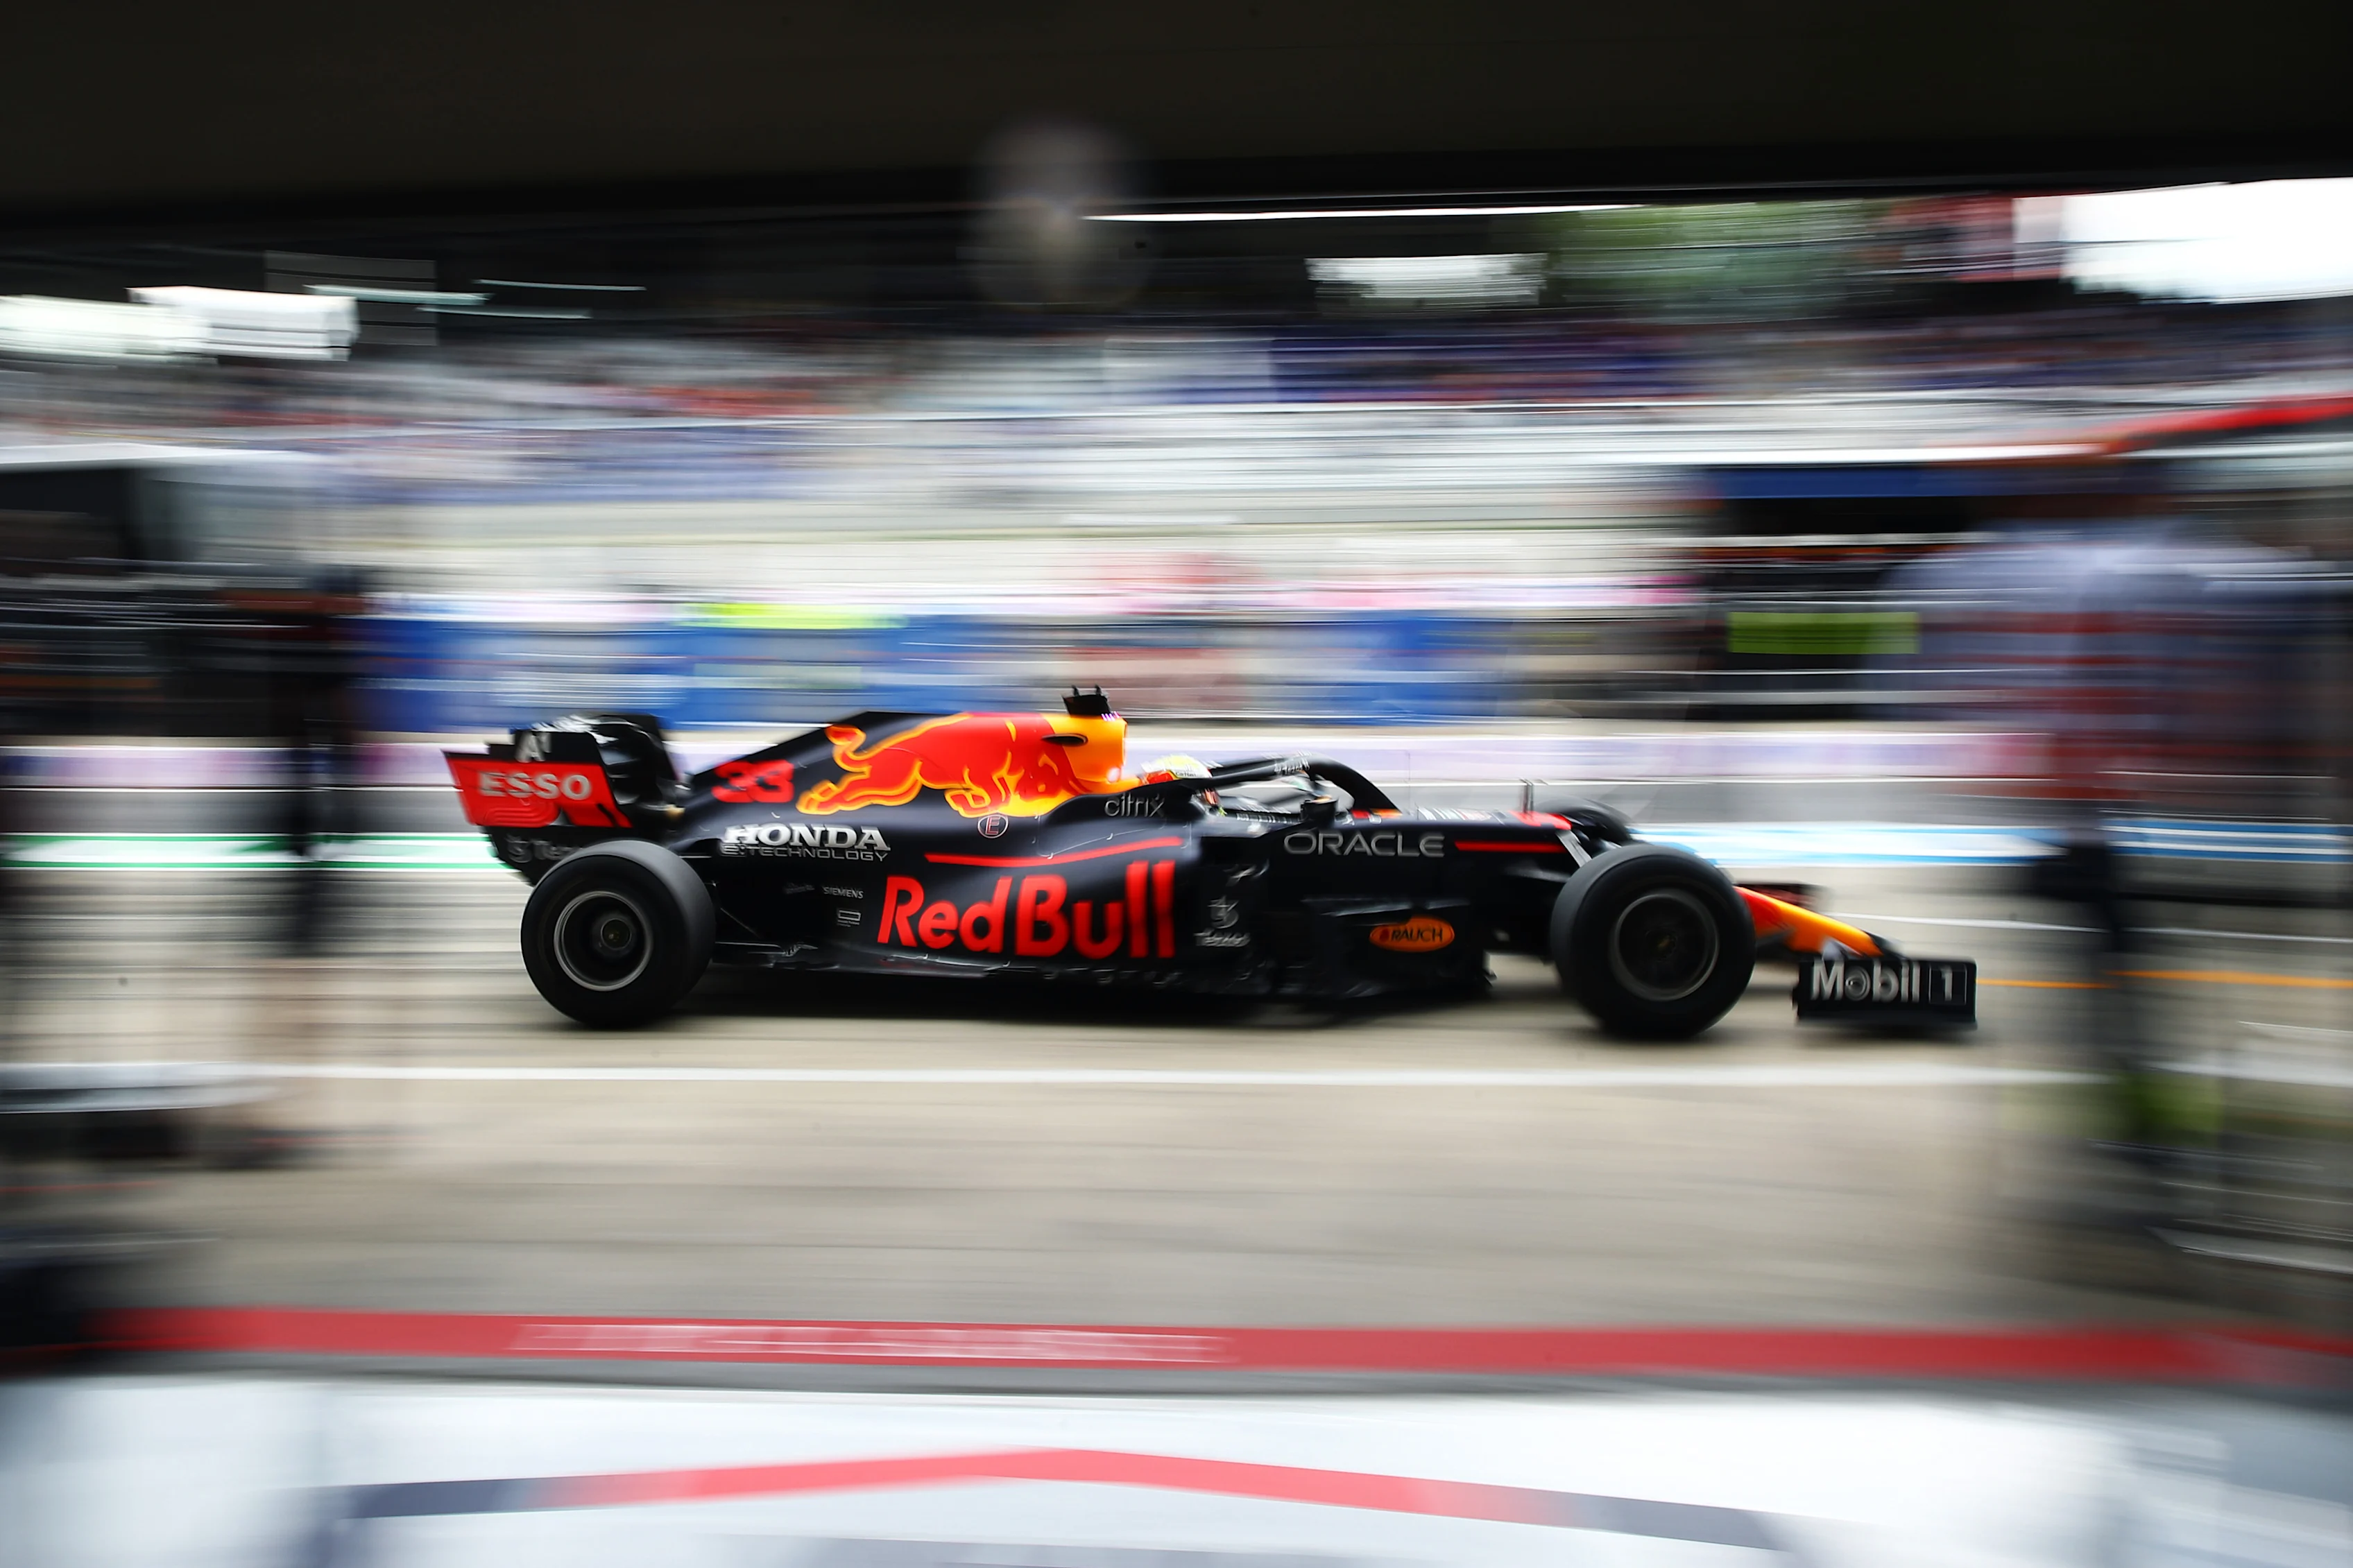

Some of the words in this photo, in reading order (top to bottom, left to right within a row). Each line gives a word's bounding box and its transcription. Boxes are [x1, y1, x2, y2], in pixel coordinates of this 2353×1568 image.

[478, 770, 592, 800] ESSO
[711, 759, 794, 803] 33
[1104, 792, 1165, 818] citrix
[722, 823, 891, 851] HONDA
[1284, 833, 1445, 857] ORACLE
[822, 886, 864, 899] SIEMENS
[1392, 927, 1443, 942] RAUCH
[1810, 959, 1920, 1002] Mobil
[1940, 965, 1955, 1001] 1
